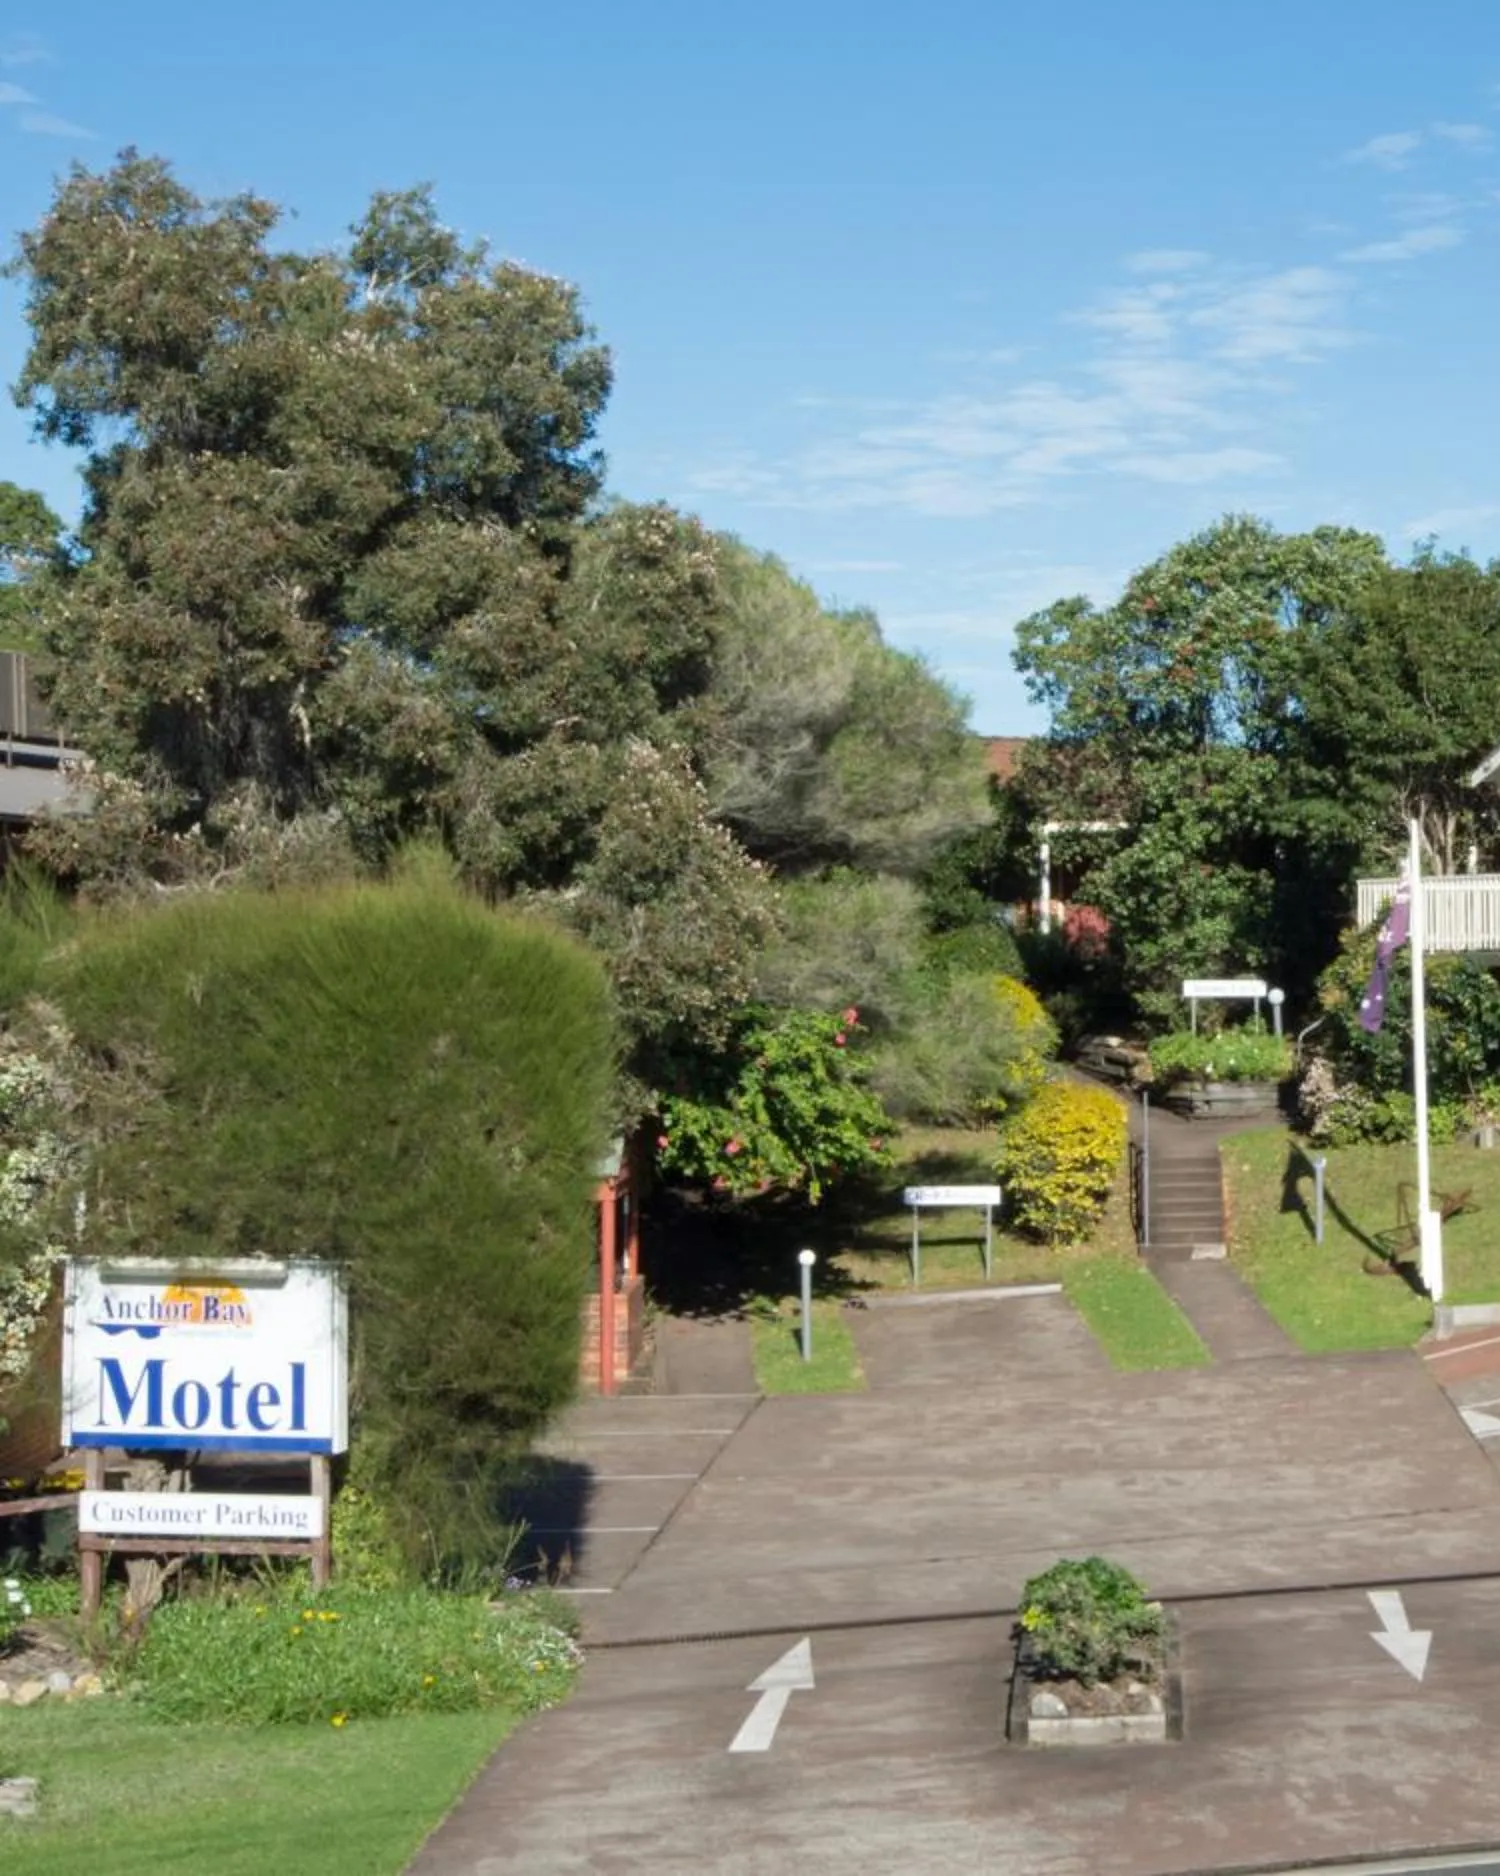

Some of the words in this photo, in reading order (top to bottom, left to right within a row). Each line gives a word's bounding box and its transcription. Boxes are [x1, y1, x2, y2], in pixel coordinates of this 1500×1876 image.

[100, 1295, 193, 1320] Anchor
[204, 1295, 248, 1328] Bay
[94, 1357, 308, 1431] Motel
[91, 1502, 207, 1523] Customer
[215, 1503, 309, 1528] Parking
